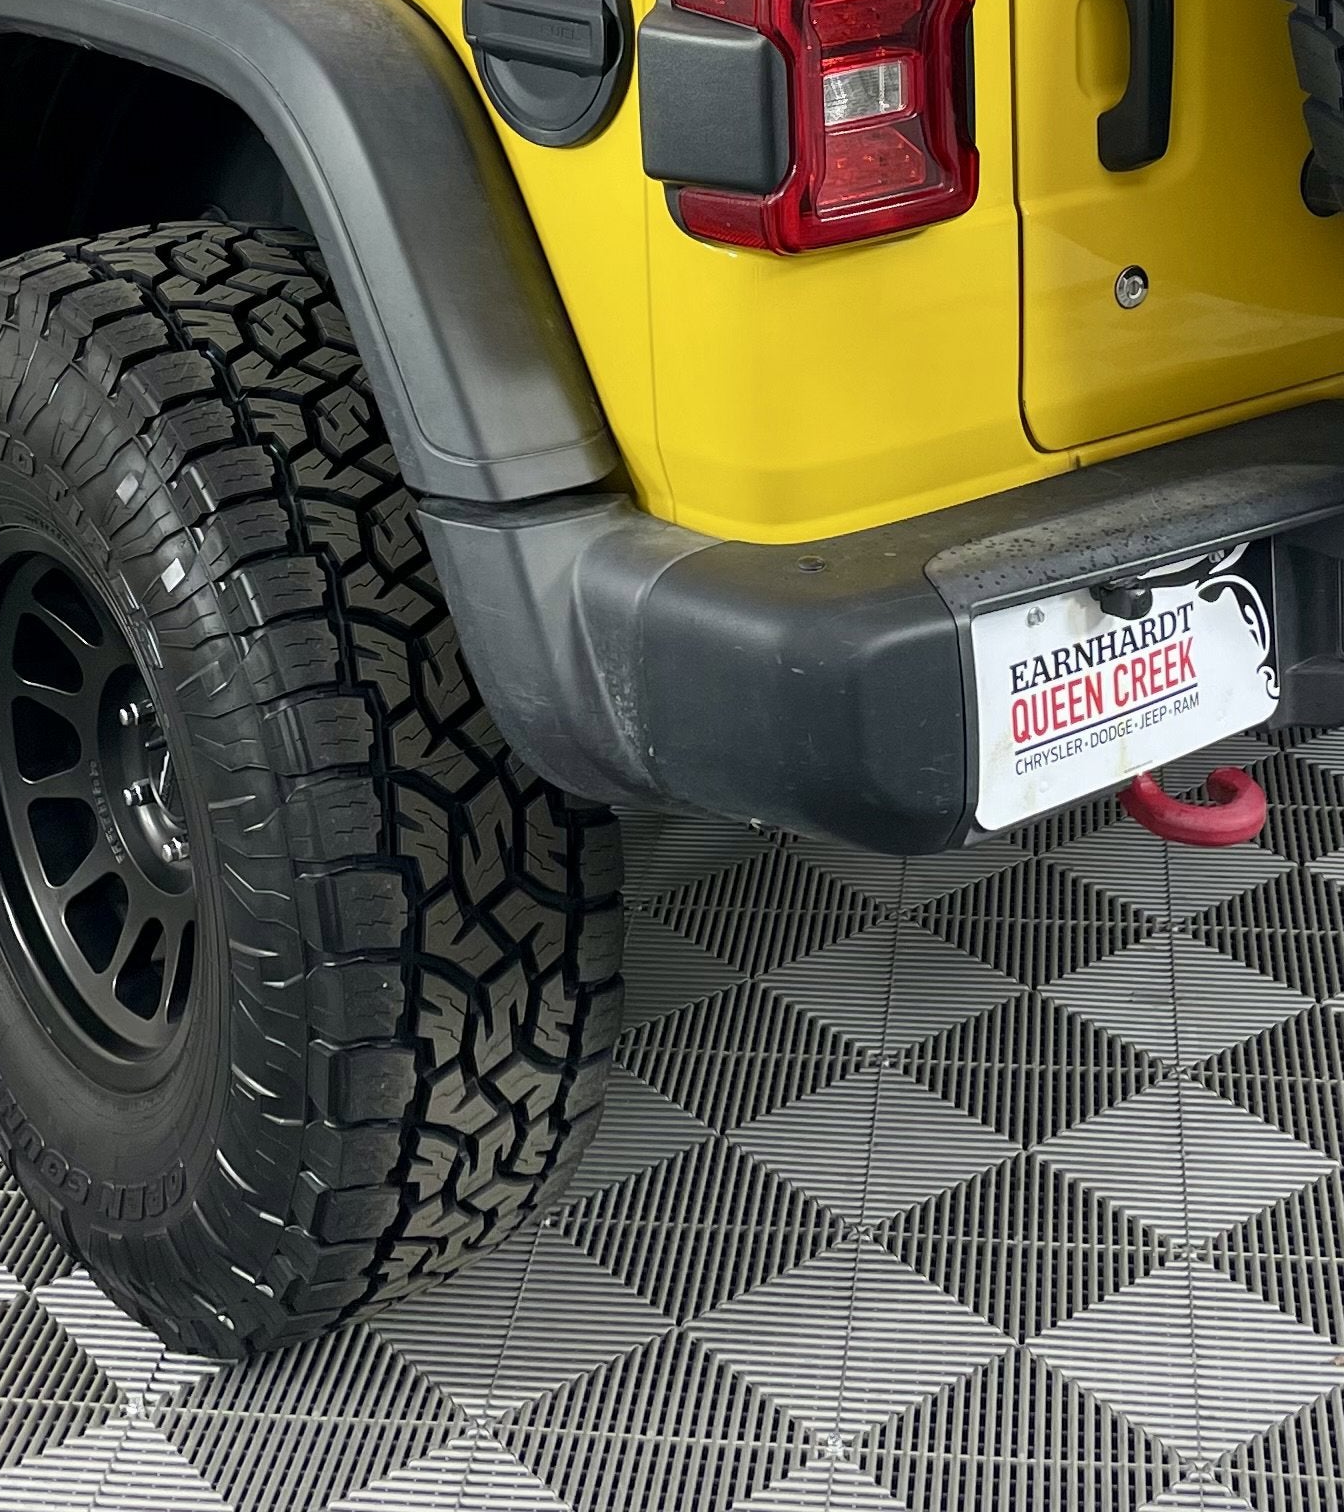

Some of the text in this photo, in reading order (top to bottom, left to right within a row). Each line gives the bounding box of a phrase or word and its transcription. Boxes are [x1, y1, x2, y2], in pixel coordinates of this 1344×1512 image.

[1009, 601, 1195, 695] EARNHARDT
[1011, 636, 1197, 744] QUEEN CREEK
[100, 1157, 187, 1220] OPEN
